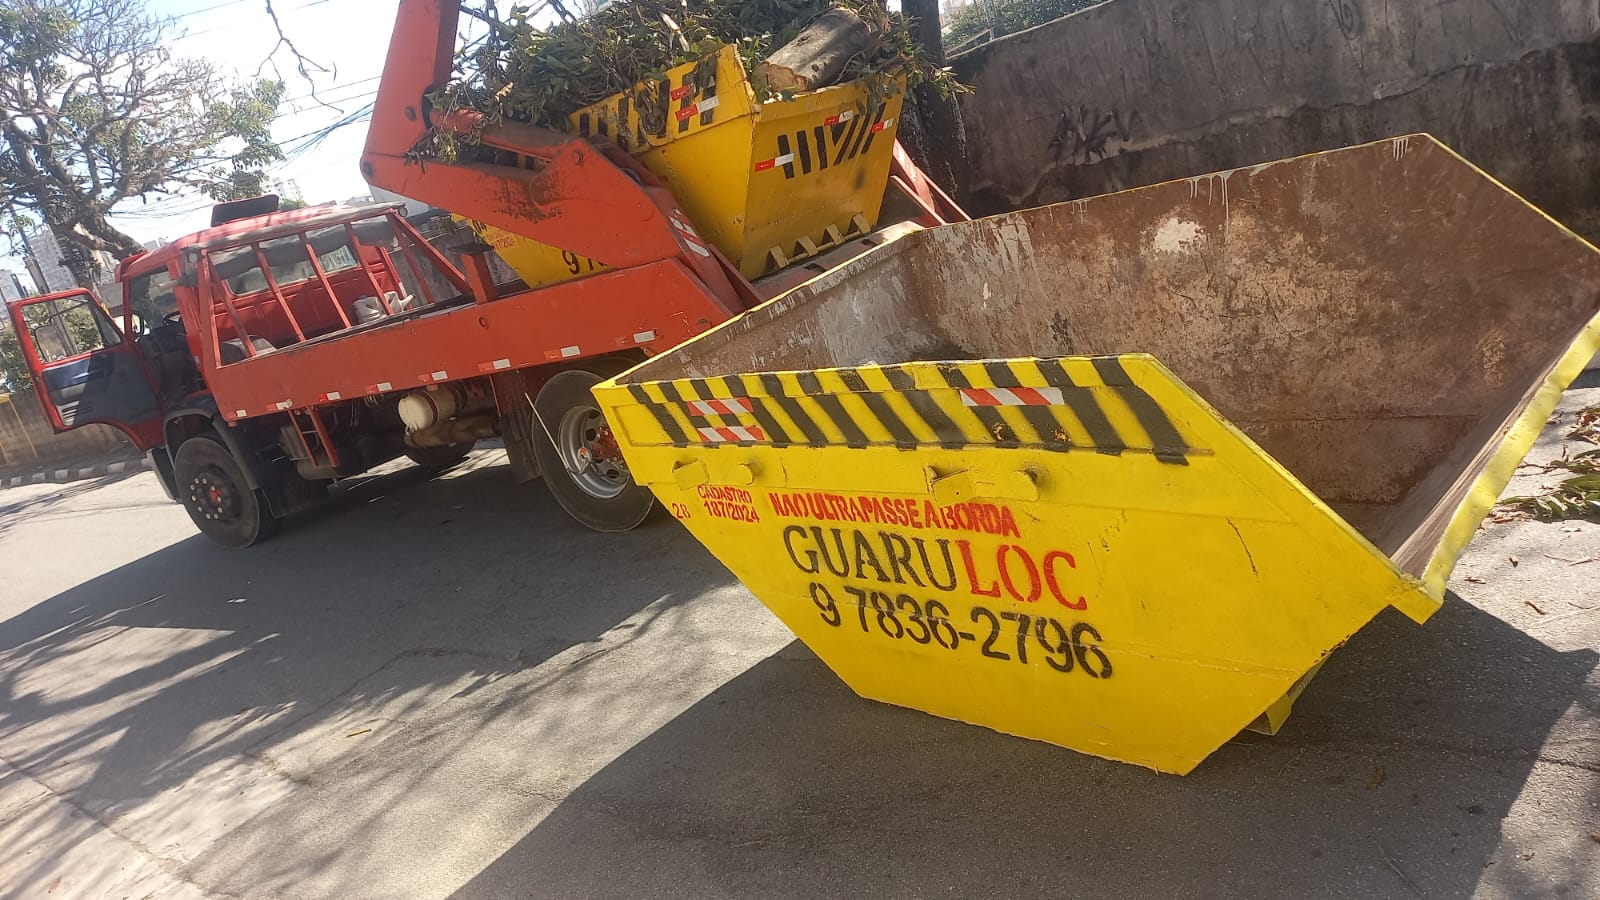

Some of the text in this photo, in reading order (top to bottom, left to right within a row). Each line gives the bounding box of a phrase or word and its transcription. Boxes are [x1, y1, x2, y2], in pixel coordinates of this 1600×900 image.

[697, 484, 752, 504] CADASTRO
[939, 502, 1021, 538] BORDA
[809, 581, 1113, 680] 9 7836-2796
